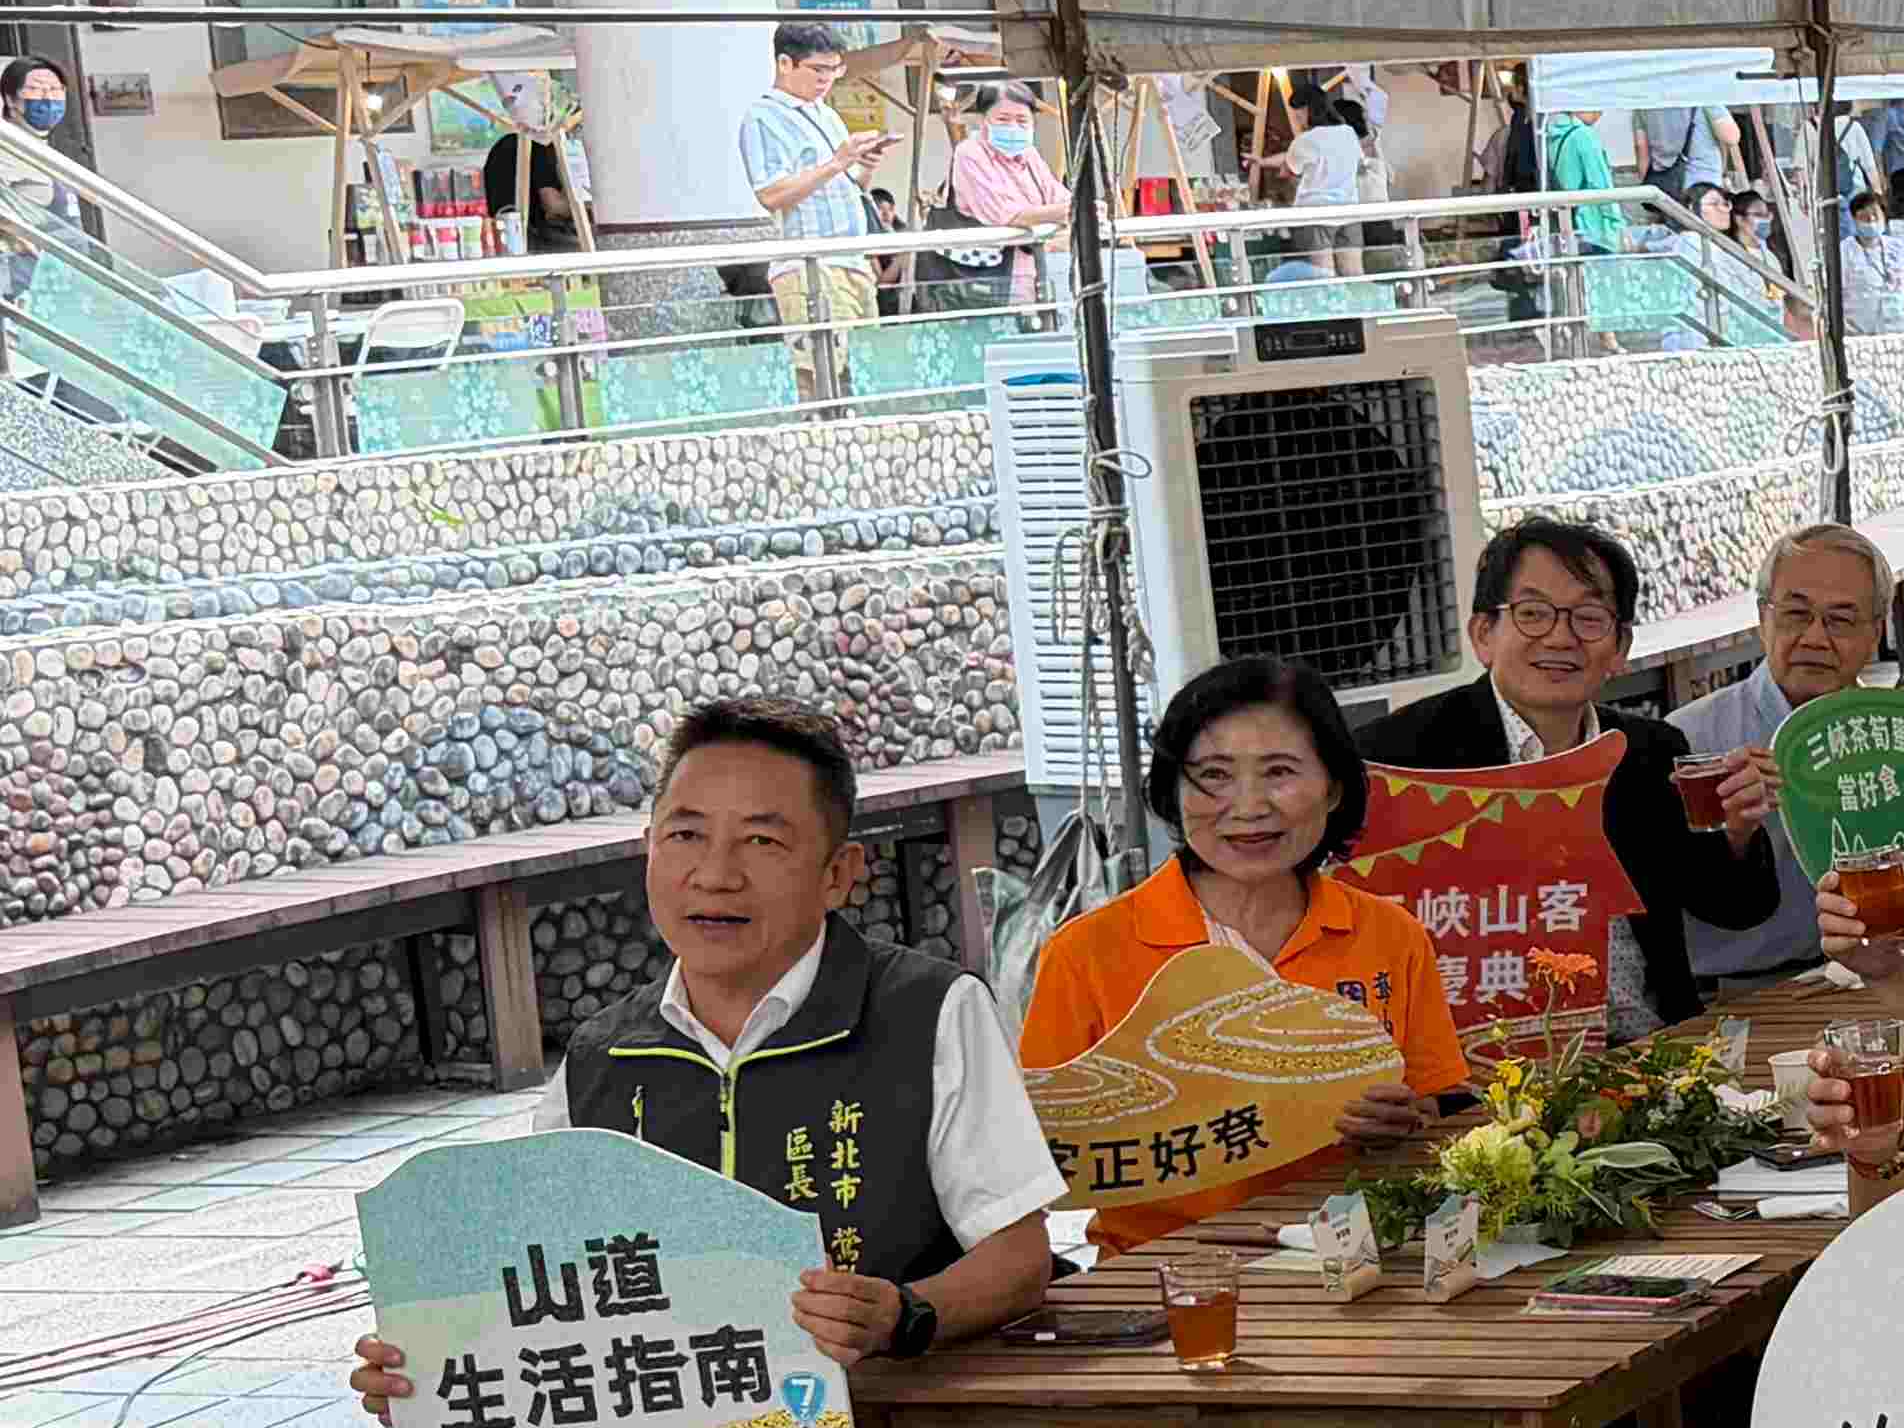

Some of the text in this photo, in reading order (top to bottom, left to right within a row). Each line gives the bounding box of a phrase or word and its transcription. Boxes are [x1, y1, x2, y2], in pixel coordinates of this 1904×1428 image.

[1838, 764, 1901, 812] 當好食
[1376, 879, 1589, 938] 峽山客
[784, 1126, 819, 1201] 區長
[828, 1100, 864, 1209] 新北市
[502, 1231, 671, 1327] 山道
